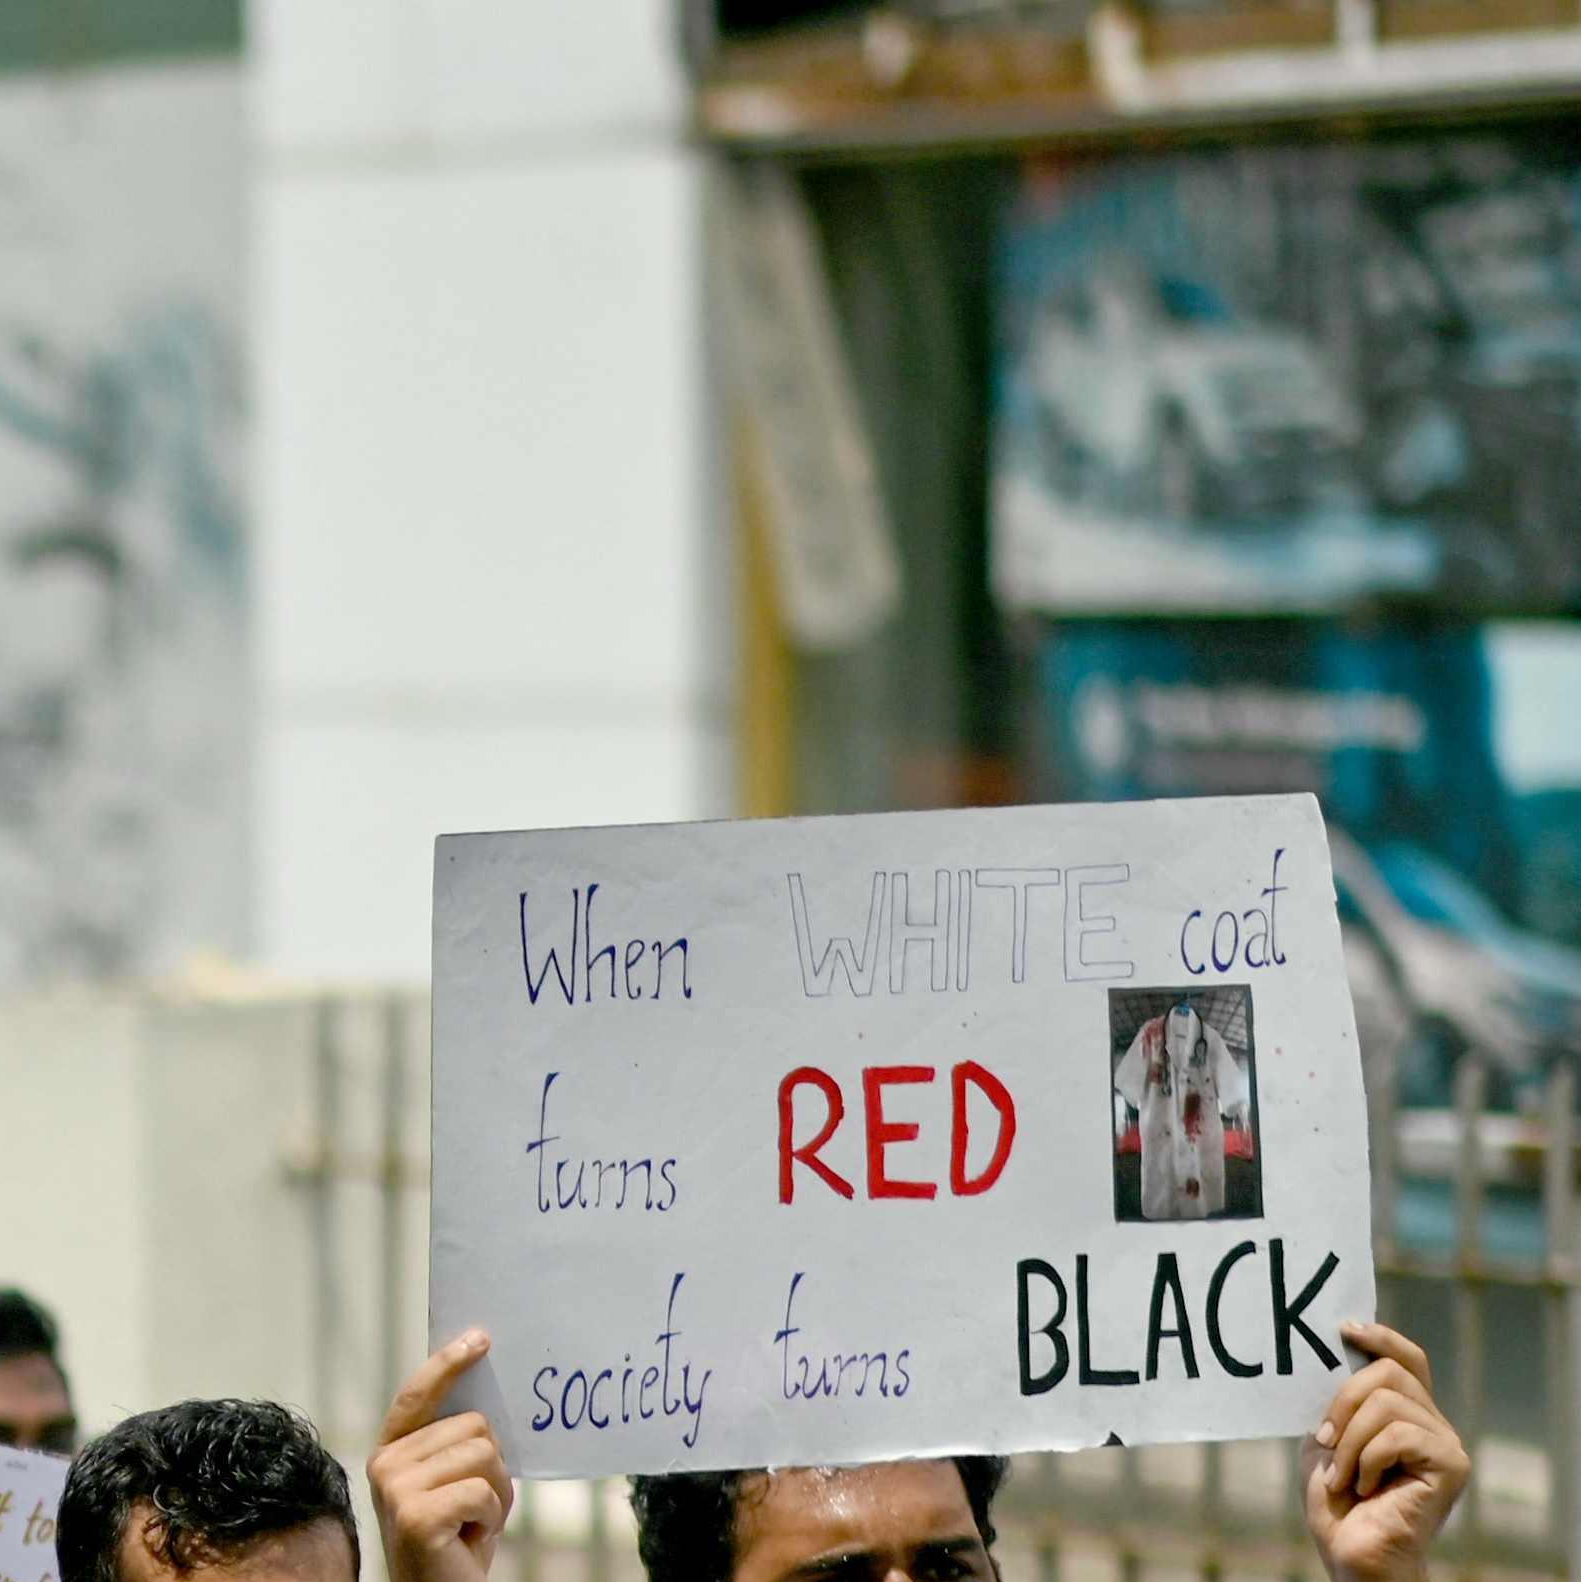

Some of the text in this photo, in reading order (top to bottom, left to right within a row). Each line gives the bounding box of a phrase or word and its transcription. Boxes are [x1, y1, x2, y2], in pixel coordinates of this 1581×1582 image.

[520, 848, 1288, 1006] When WHITE coat
[525, 1059, 1018, 1214] turns RED
[531, 1238, 1343, 1449] society turns BLACK
